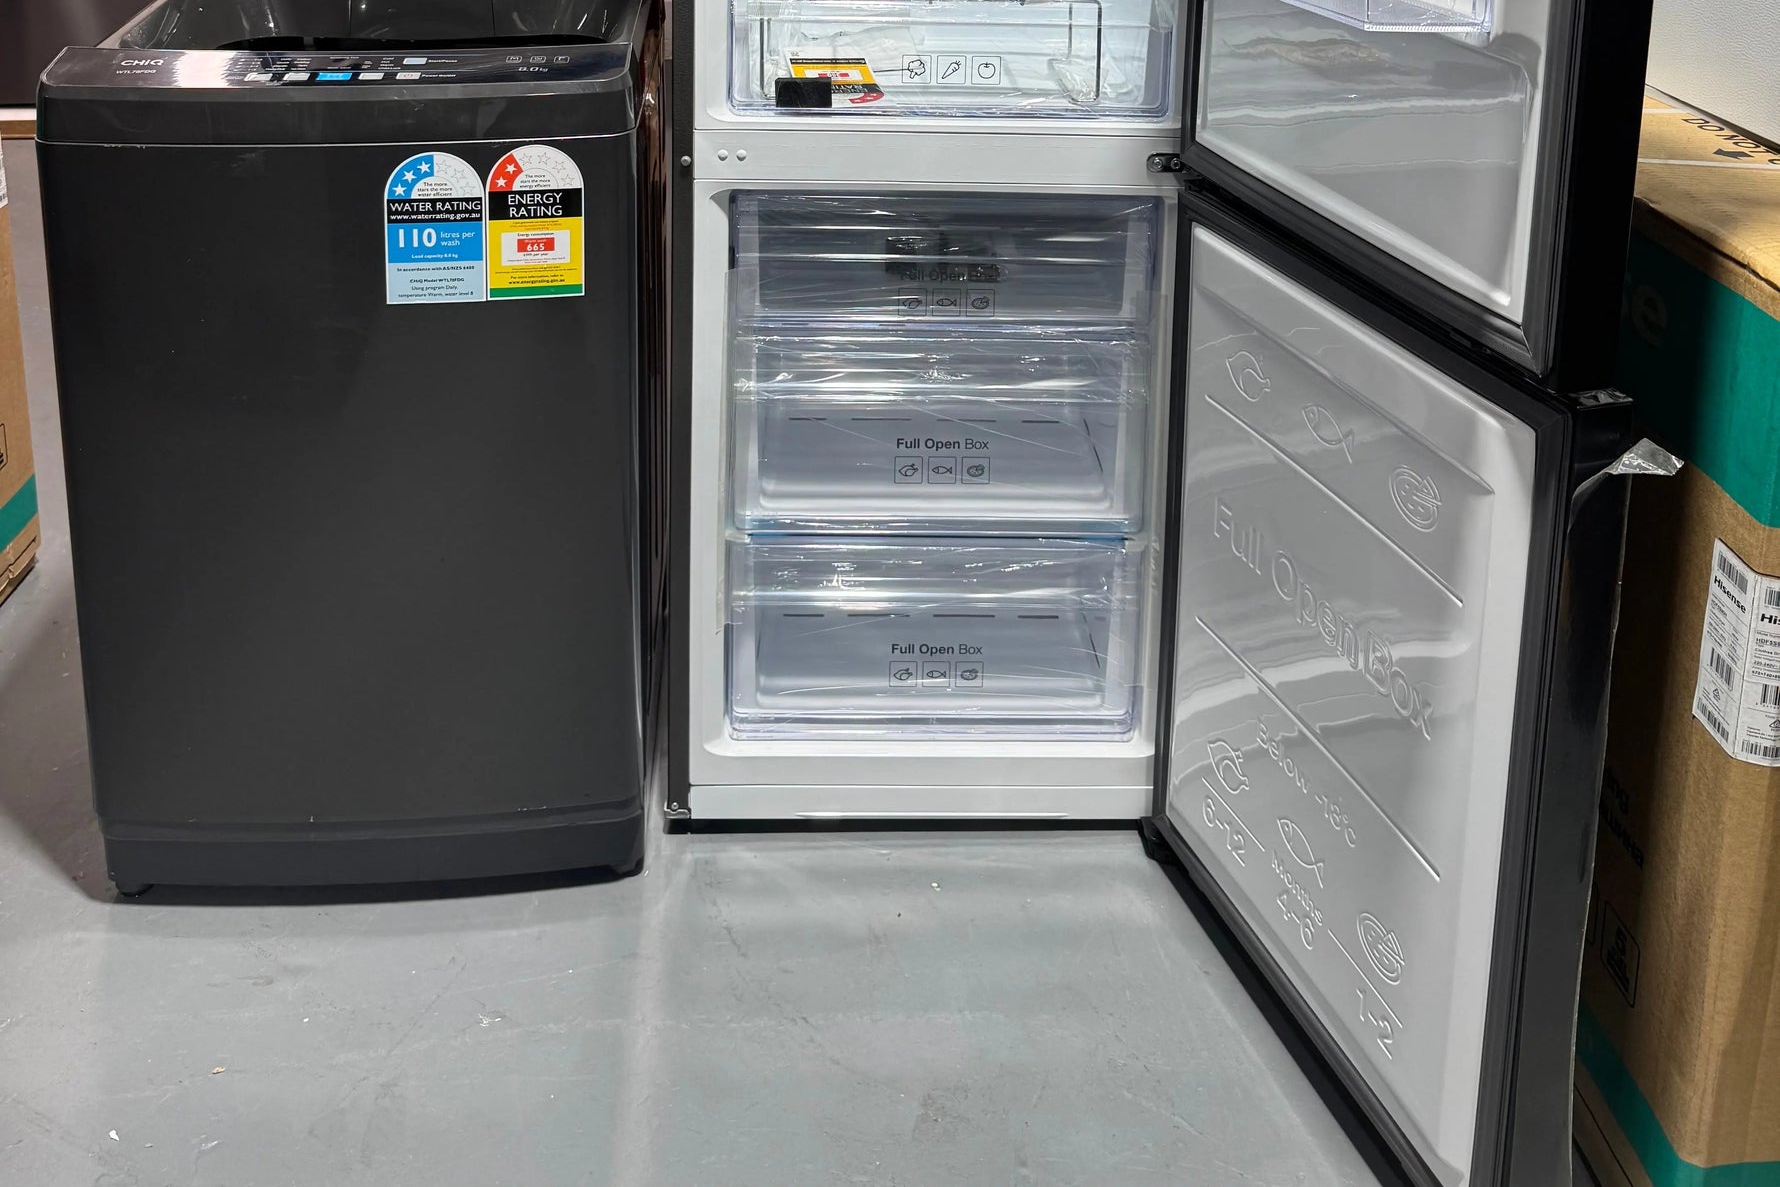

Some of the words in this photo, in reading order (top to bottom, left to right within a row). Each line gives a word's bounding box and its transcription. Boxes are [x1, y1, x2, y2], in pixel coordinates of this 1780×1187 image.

[1681, 118, 1726, 131] DO
[390, 202, 433, 212] WATER
[436, 201, 481, 211] RATING
[508, 193, 562, 205] ENERGY
[510, 206, 562, 218] RATING
[398, 228, 437, 248] 110
[527, 243, 545, 251] 665
[929, 269, 966, 282] Open
[896, 438, 920, 451] Full
[925, 438, 961, 454] Open
[964, 438, 990, 451] Box
[1714, 576, 1747, 614] Hisense
[1212, 496, 1264, 576] Full
[1272, 549, 1361, 670] Open
[1362, 628, 1433, 742] Box
[891, 643, 915, 656] Full
[919, 643, 955, 660] Open
[958, 643, 983, 656] Box
[1255, 719, 1309, 795] Below
[1201, 795, 1247, 868] 6-12
[1355, 987, 1394, 1061] 1-2
